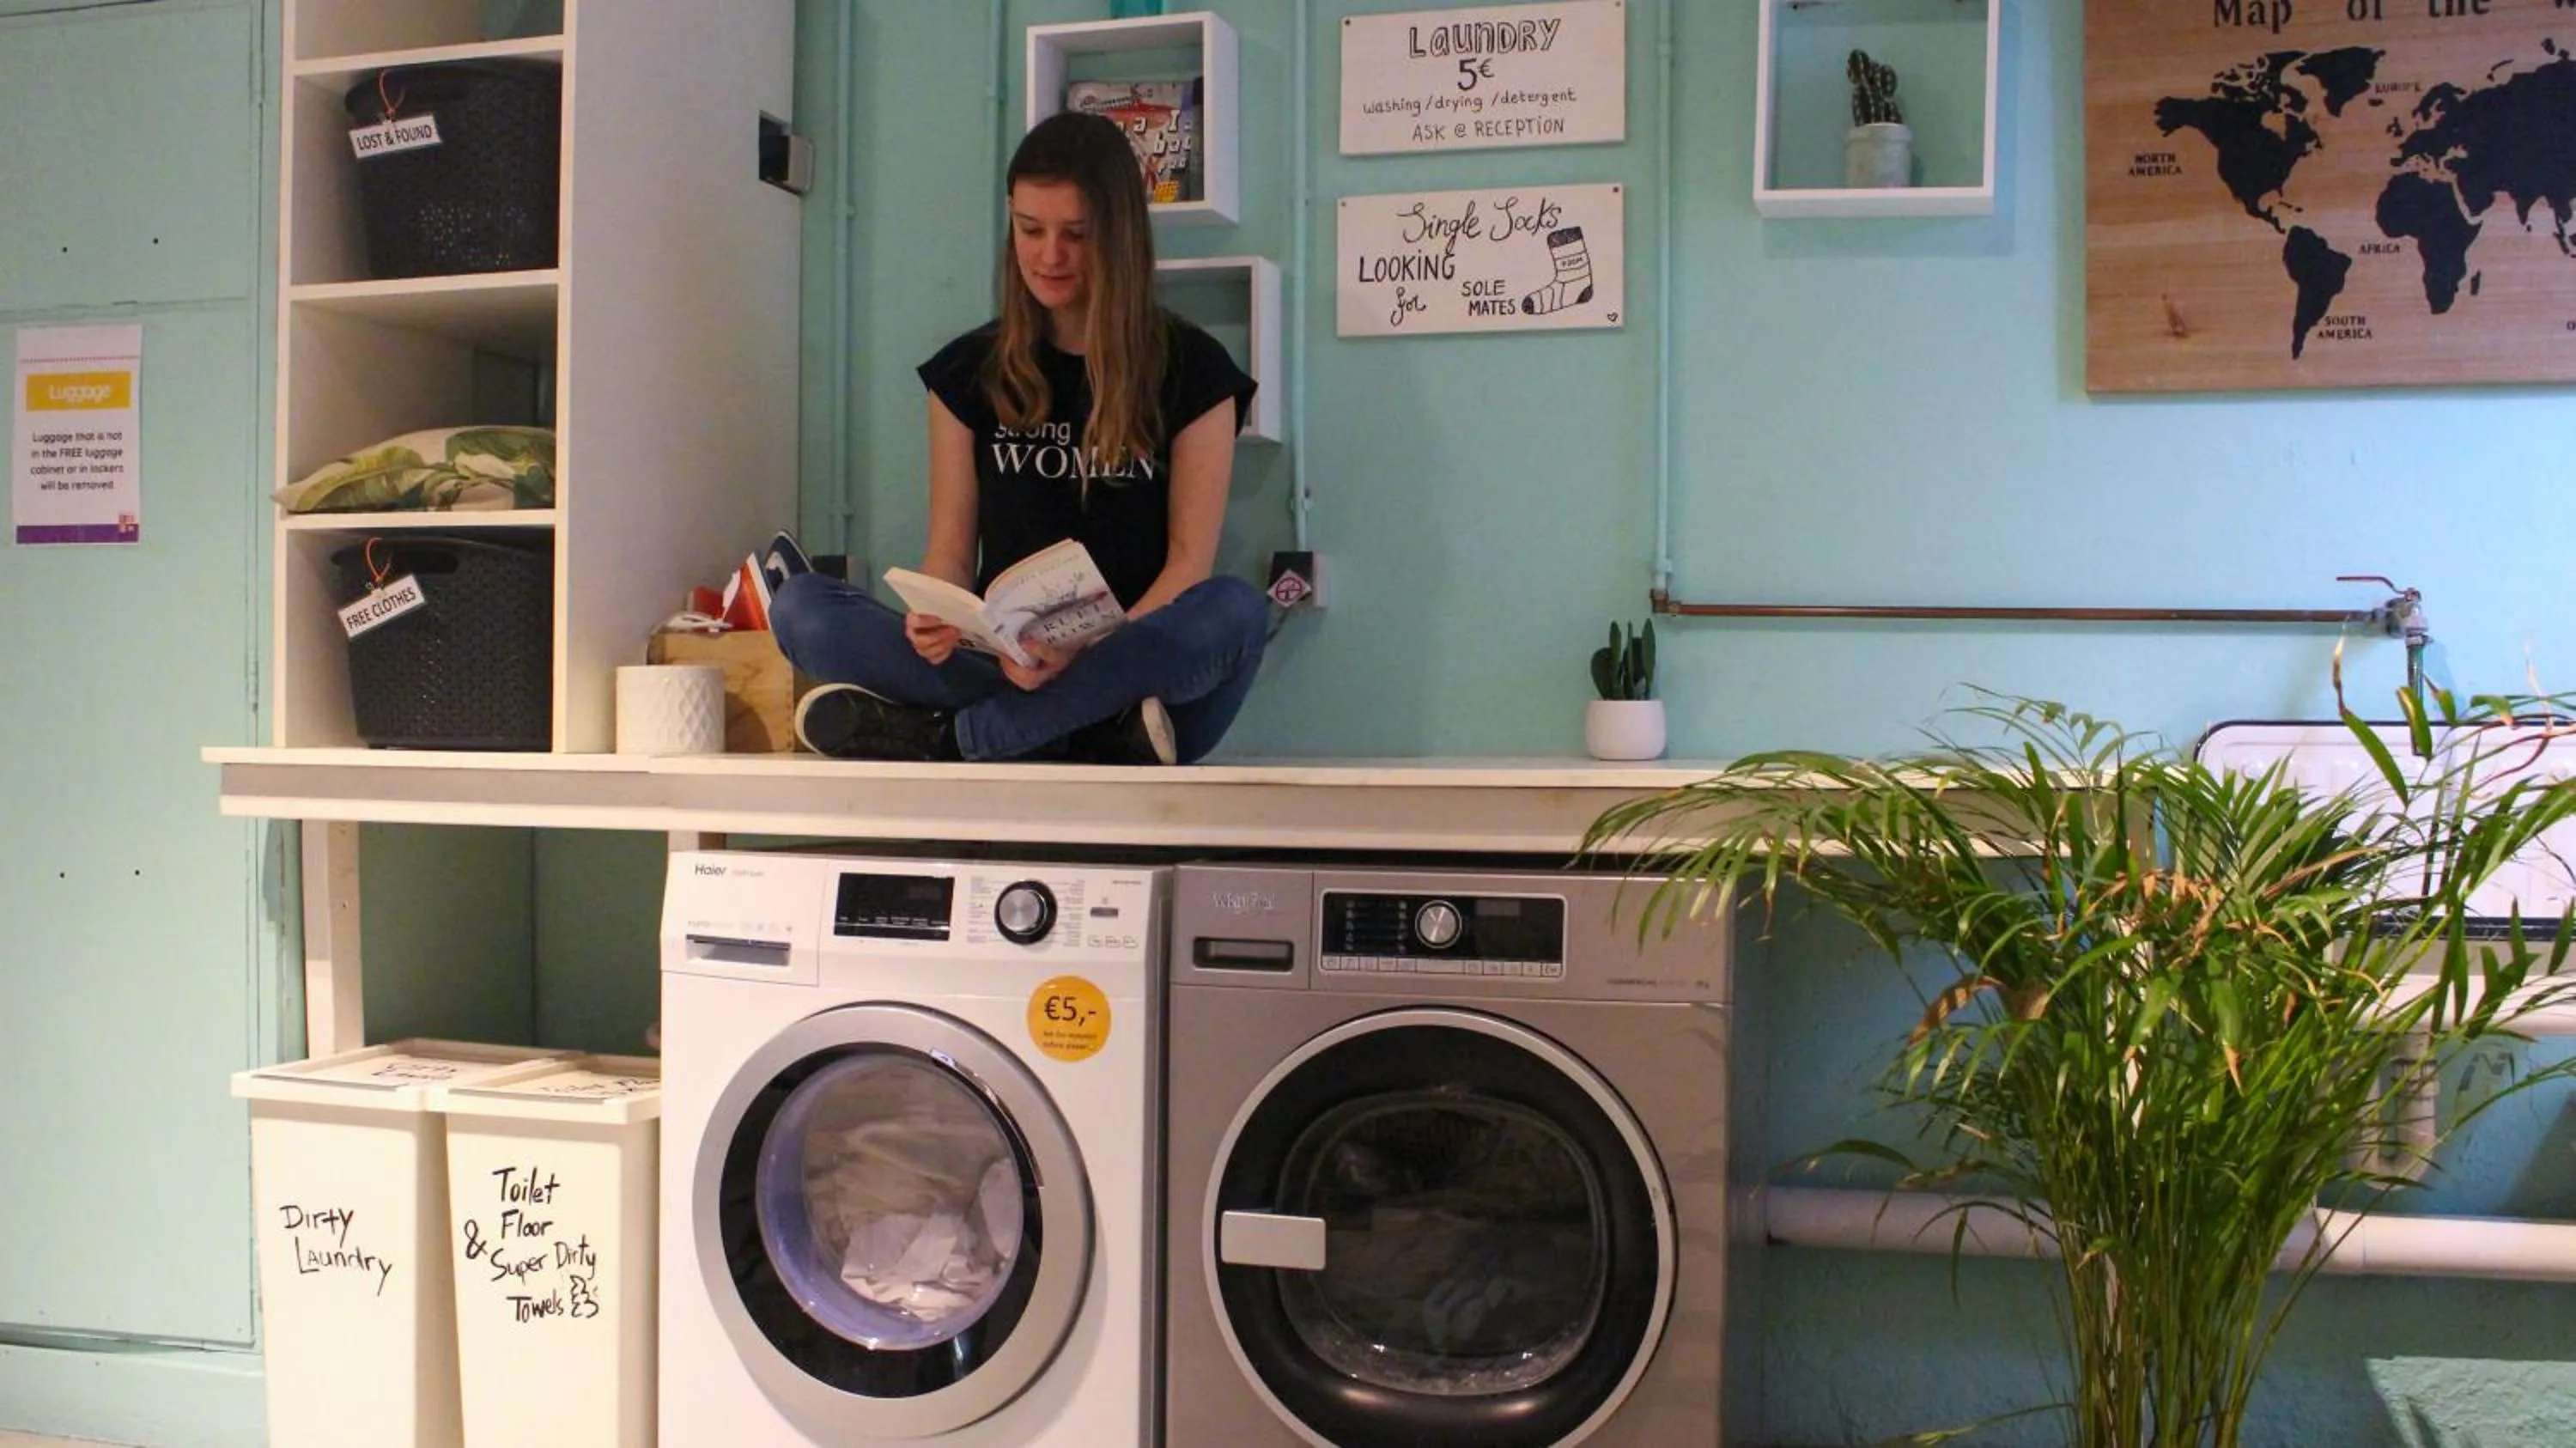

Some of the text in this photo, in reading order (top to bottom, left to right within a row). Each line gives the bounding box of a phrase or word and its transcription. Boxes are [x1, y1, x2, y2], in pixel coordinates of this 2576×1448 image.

[2213, 0, 2293, 34] Map
[356, 125, 433, 150] LOST & FOUND
[1412, 122, 1447, 143] ASK
[1454, 124, 1467, 139] @
[2135, 153, 2176, 163] NORTH
[2129, 166, 2184, 177] AMERICA
[1395, 196, 1563, 256] Single Socks
[2358, 243, 2401, 255] AFRICA
[1461, 280, 1506, 297] SOLE
[1468, 299, 1516, 317] MATES
[2324, 315, 2366, 325] SOUTH
[2317, 328, 2372, 339] AMERICA
[49, 384, 111, 404] Luggage
[33, 432, 72, 443] Luggage
[76, 431, 94, 441] that
[106, 431, 122, 441] not
[994, 420, 1071, 446] song
[42, 448, 57, 457] the
[60, 447, 82, 457] FREE
[86, 447, 123, 459] luggage
[30, 465, 64, 475] cabinet
[67, 465, 76, 474] or
[90, 464, 124, 473] lockers
[41, 480, 55, 490] will
[58, 480, 69, 490] be
[347, 587, 416, 629] FREE CLOTHES
[695, 862, 727, 876] Haier
[492, 1166, 561, 1206] Toilet
[279, 1205, 354, 1248] Dirty
[501, 1209, 554, 1239] Floor
[464, 1219, 597, 1285] & Super Dirty
[506, 1287, 564, 1323] Towels
